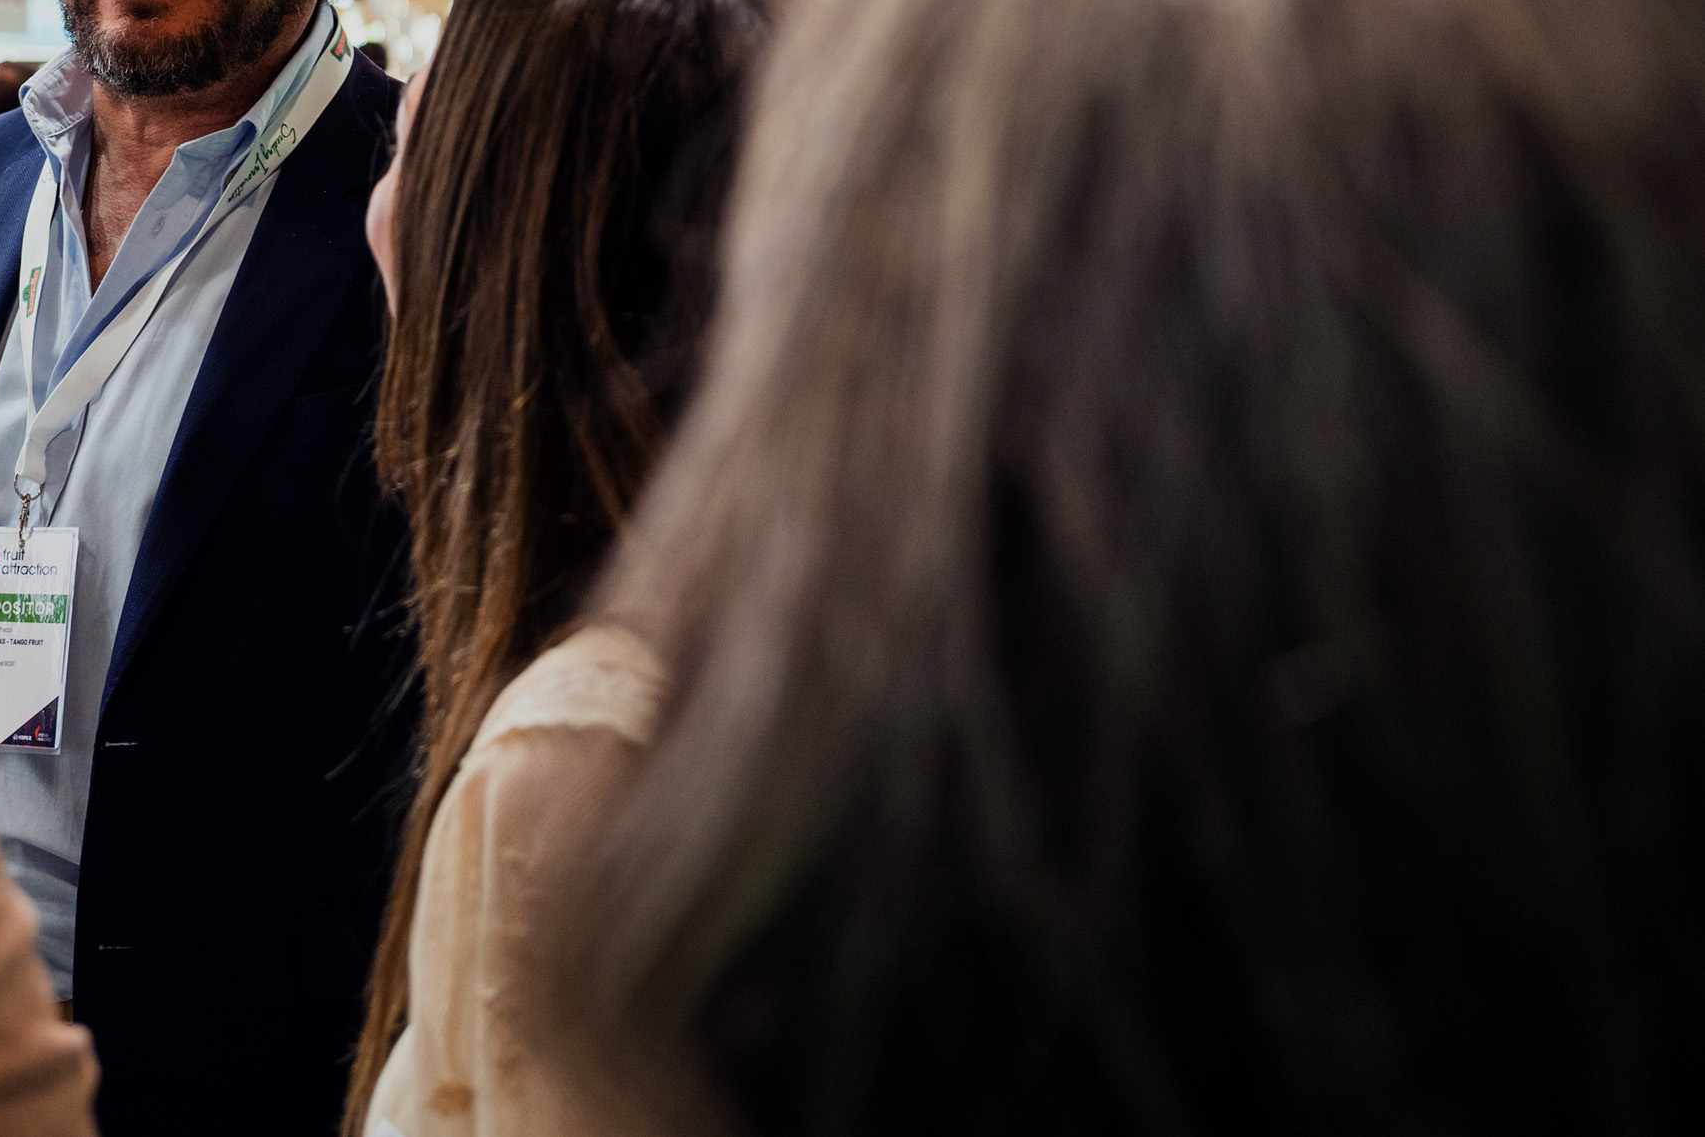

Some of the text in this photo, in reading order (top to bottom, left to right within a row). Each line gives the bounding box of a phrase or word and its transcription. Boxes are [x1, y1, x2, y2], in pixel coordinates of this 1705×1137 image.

[3, 548, 25, 561] fruit
[1, 563, 58, 576] attraction
[10, 638, 28, 646] TANGO
